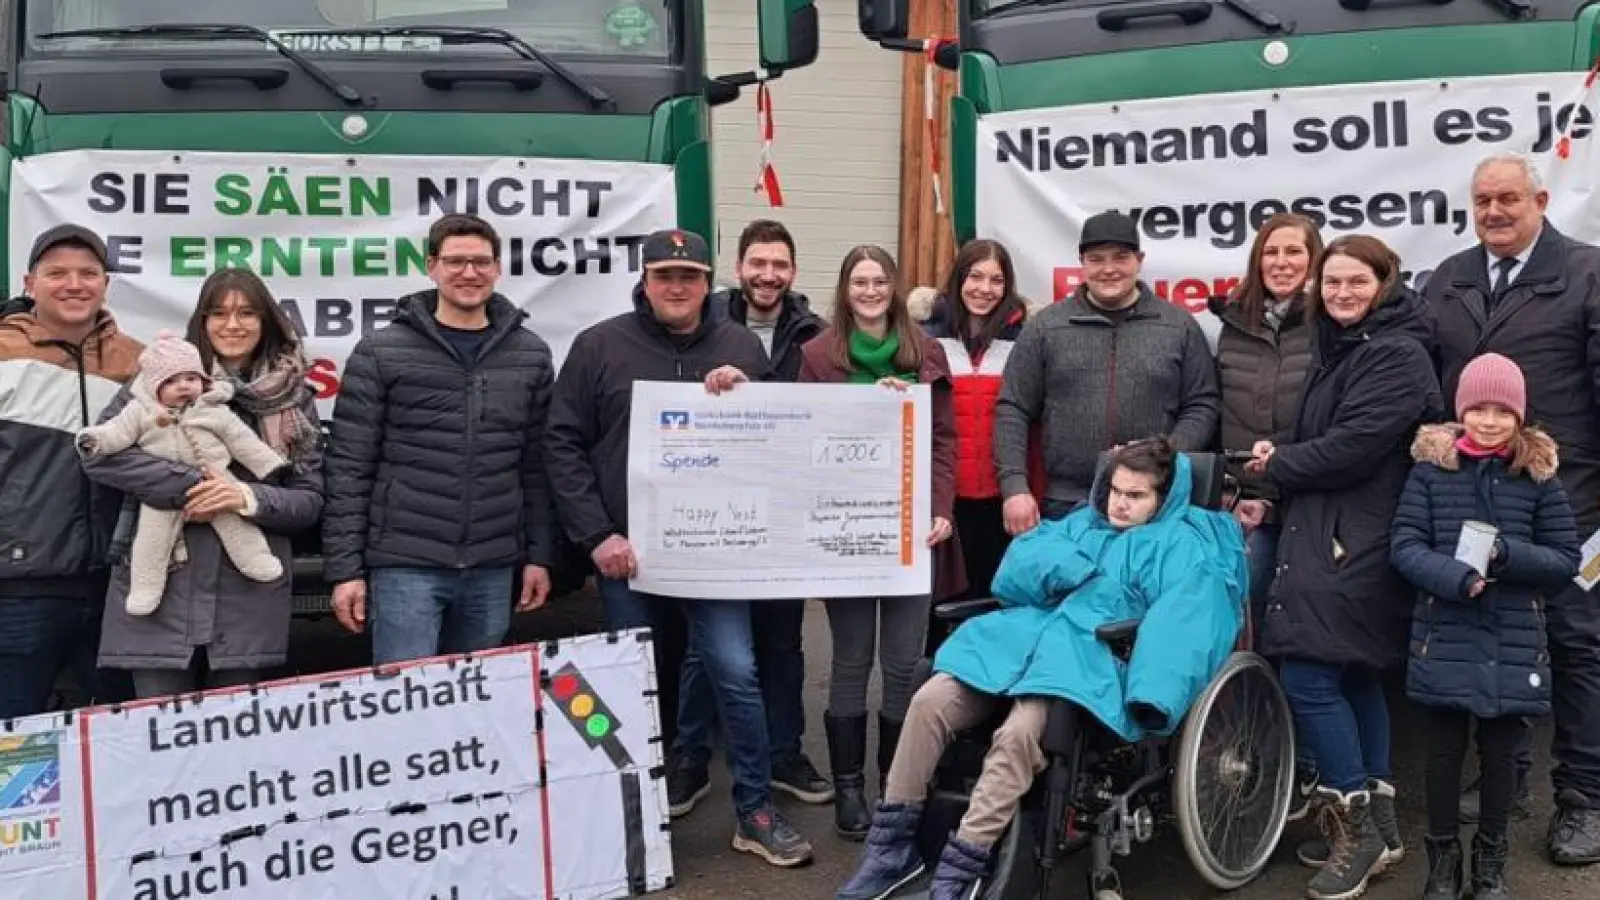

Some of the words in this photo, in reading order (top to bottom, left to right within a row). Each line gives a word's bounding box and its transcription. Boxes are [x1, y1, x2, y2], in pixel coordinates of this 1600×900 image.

[994, 109, 1267, 172] Niemand
[1292, 99, 1408, 153] soll
[1433, 106, 1513, 145] es
[1531, 92, 1594, 152] je
[88, 172, 190, 214] SIE
[214, 167, 391, 216] SÄEN
[417, 177, 612, 217] NICHT
[170, 237, 428, 277] ERNTEN
[510, 236, 643, 276] ICHT
[280, 298, 398, 338] ABE
[660, 451, 721, 474] Spende
[148, 665, 491, 752] Landwirtschaft
[148, 770, 297, 826] macht
[312, 753, 391, 797] alle
[407, 736, 500, 780] satt,
[132, 852, 248, 900] auch
[264, 840, 335, 882] die
[350, 811, 518, 863] Gegner,
